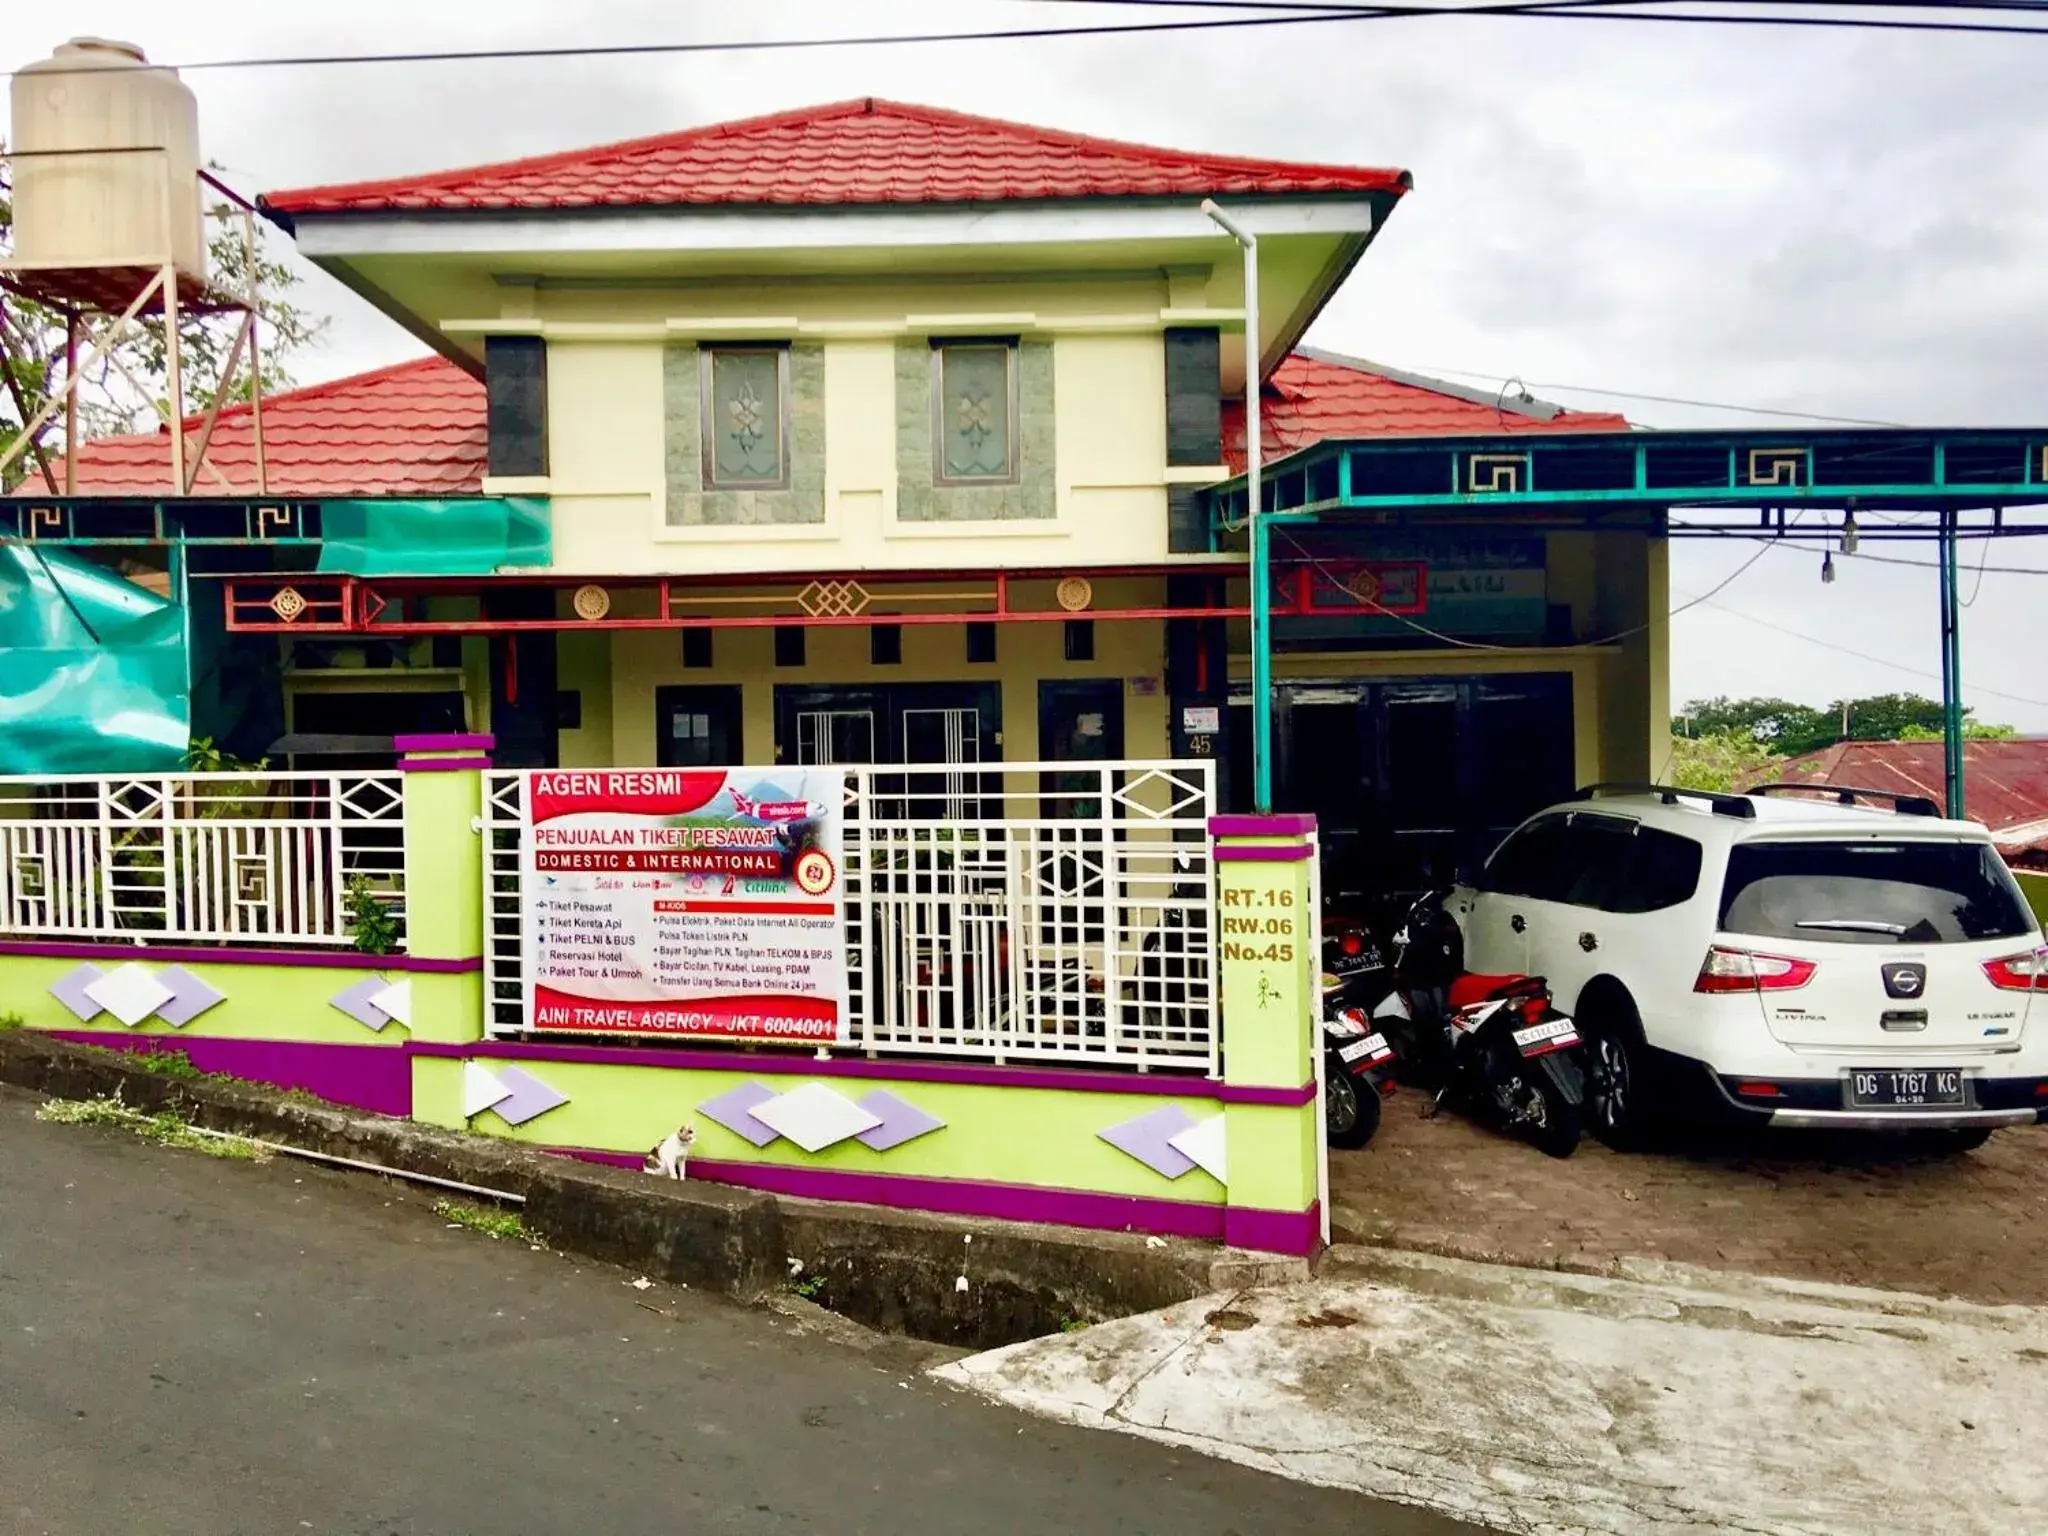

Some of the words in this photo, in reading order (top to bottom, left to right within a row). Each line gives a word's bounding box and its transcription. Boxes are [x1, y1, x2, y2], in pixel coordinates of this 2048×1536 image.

[1190, 735, 1211, 753] 45
[537, 774, 601, 796] AGEN
[608, 773, 681, 796] RESMI
[535, 829, 635, 845] PENJUALAN
[640, 829, 687, 845] TIKET
[693, 829, 775, 845] PESAWAT
[539, 854, 619, 868] DOMESTIC
[627, 855, 636, 868] &
[643, 855, 776, 869] INTERNATIONAL
[1224, 888, 1294, 909] RT.16
[549, 900, 571, 911] Tiket
[573, 901, 612, 912] Pesawat
[549, 917, 572, 927] Tiket
[574, 918, 603, 928] Kereta
[604, 919, 622, 930] Api
[659, 916, 680, 925] Pulsa
[714, 917, 736, 926] Paket
[737, 917, 755, 927] Data
[757, 918, 786, 928] Internet
[788, 919, 798, 928] All
[800, 919, 835, 930] Operator
[1223, 917, 1293, 935] RW.06
[549, 934, 572, 943] Tiket
[574, 934, 603, 944] PELNI
[605, 936, 612, 945] &
[613, 935, 636, 946] BUS
[659, 931, 680, 940] Pulsa
[681, 931, 704, 940] Token
[706, 932, 729, 941] Listrik
[732, 932, 748, 942] PLN
[549, 950, 595, 960] Reservasi
[597, 951, 622, 962] Hotel
[659, 946, 681, 957] Bayar
[683, 946, 713, 957] Tagihan
[735, 947, 765, 959] Tagihan
[767, 948, 801, 958] TELKOM
[802, 950, 809, 959] &
[811, 950, 832, 960] BPJS
[1223, 942, 1294, 962] No.45
[549, 966, 576, 977] Paket
[579, 967, 599, 978] Tour
[601, 968, 608, 978] &
[611, 968, 643, 979] Umroh
[659, 961, 682, 972] Bayar
[713, 962, 723, 971] TV
[786, 965, 810, 974] PDAM
[659, 976, 691, 985] Transfer
[692, 977, 712, 988] Uang
[742, 978, 761, 988] Bank
[764, 979, 789, 989] Online
[791, 981, 800, 989] 24
[537, 1007, 570, 1024] AINI
[573, 1008, 637, 1028] TRAVEL
[639, 1011, 713, 1031] AGENCY
[726, 1014, 761, 1033] JKT
[763, 1016, 833, 1036] 6004001
[1856, 1074, 1878, 1094] DG
[1890, 1073, 1928, 1094] 1767
[1936, 1073, 1957, 1093] KC
